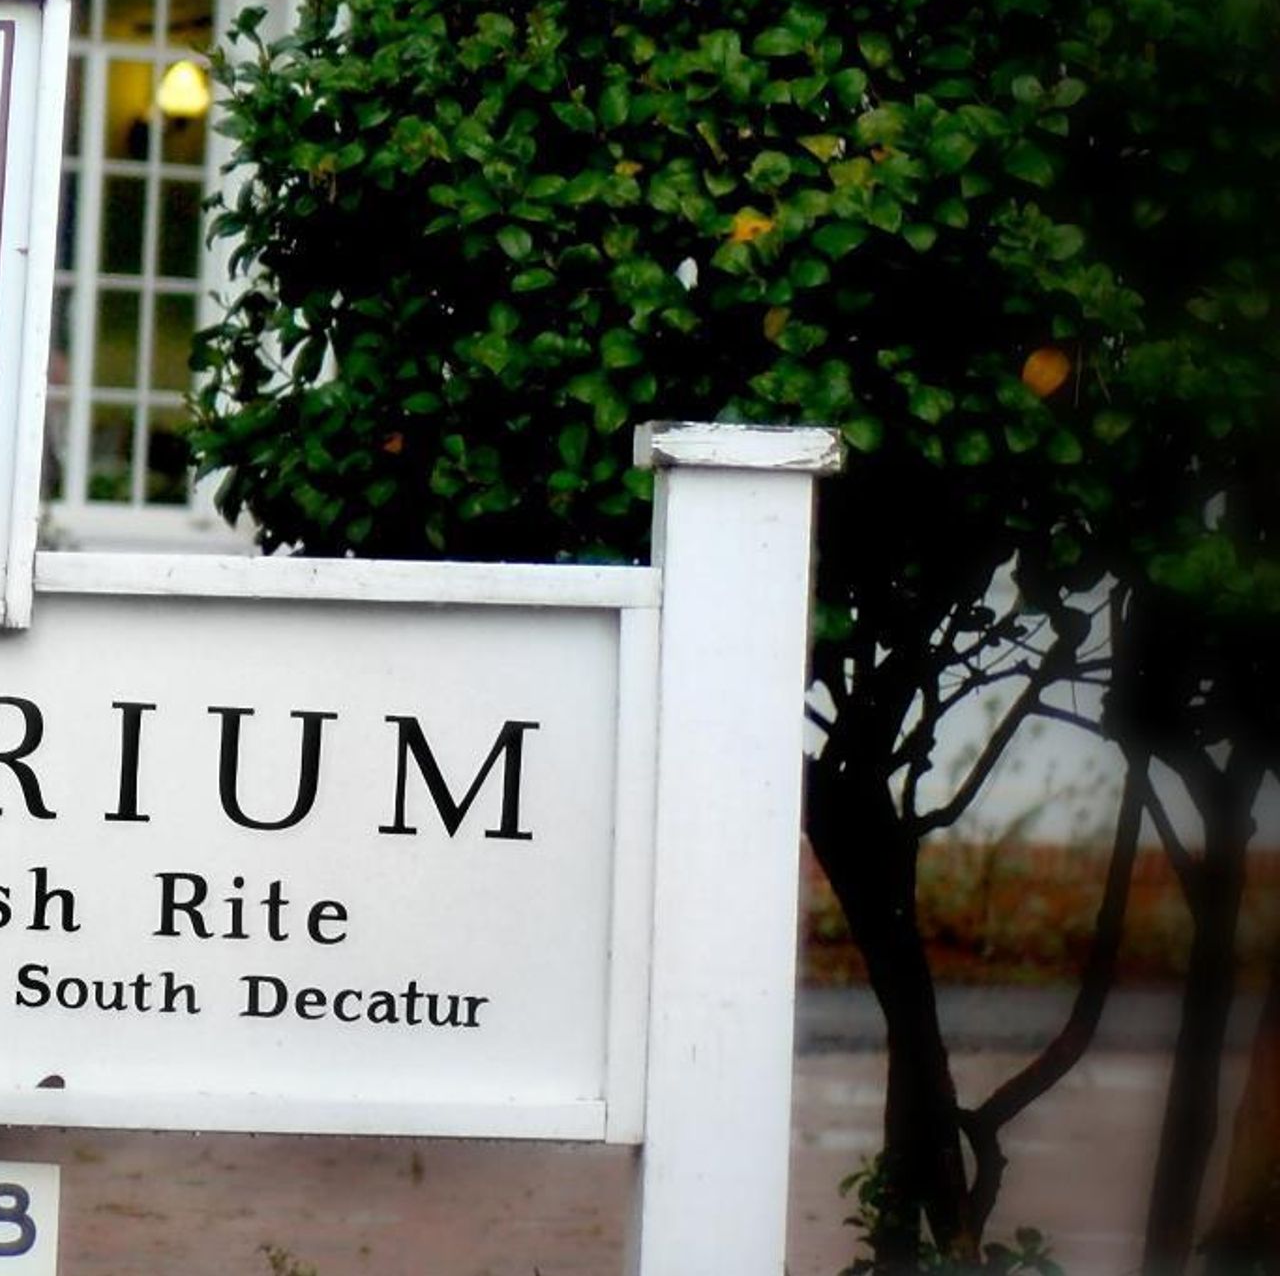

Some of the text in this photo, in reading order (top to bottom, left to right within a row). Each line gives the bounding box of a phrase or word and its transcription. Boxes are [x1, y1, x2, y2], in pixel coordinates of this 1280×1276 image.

[153, 873, 347, 944] Rite
[16, 964, 200, 1014] South
[240, 976, 489, 1027] Decatur
